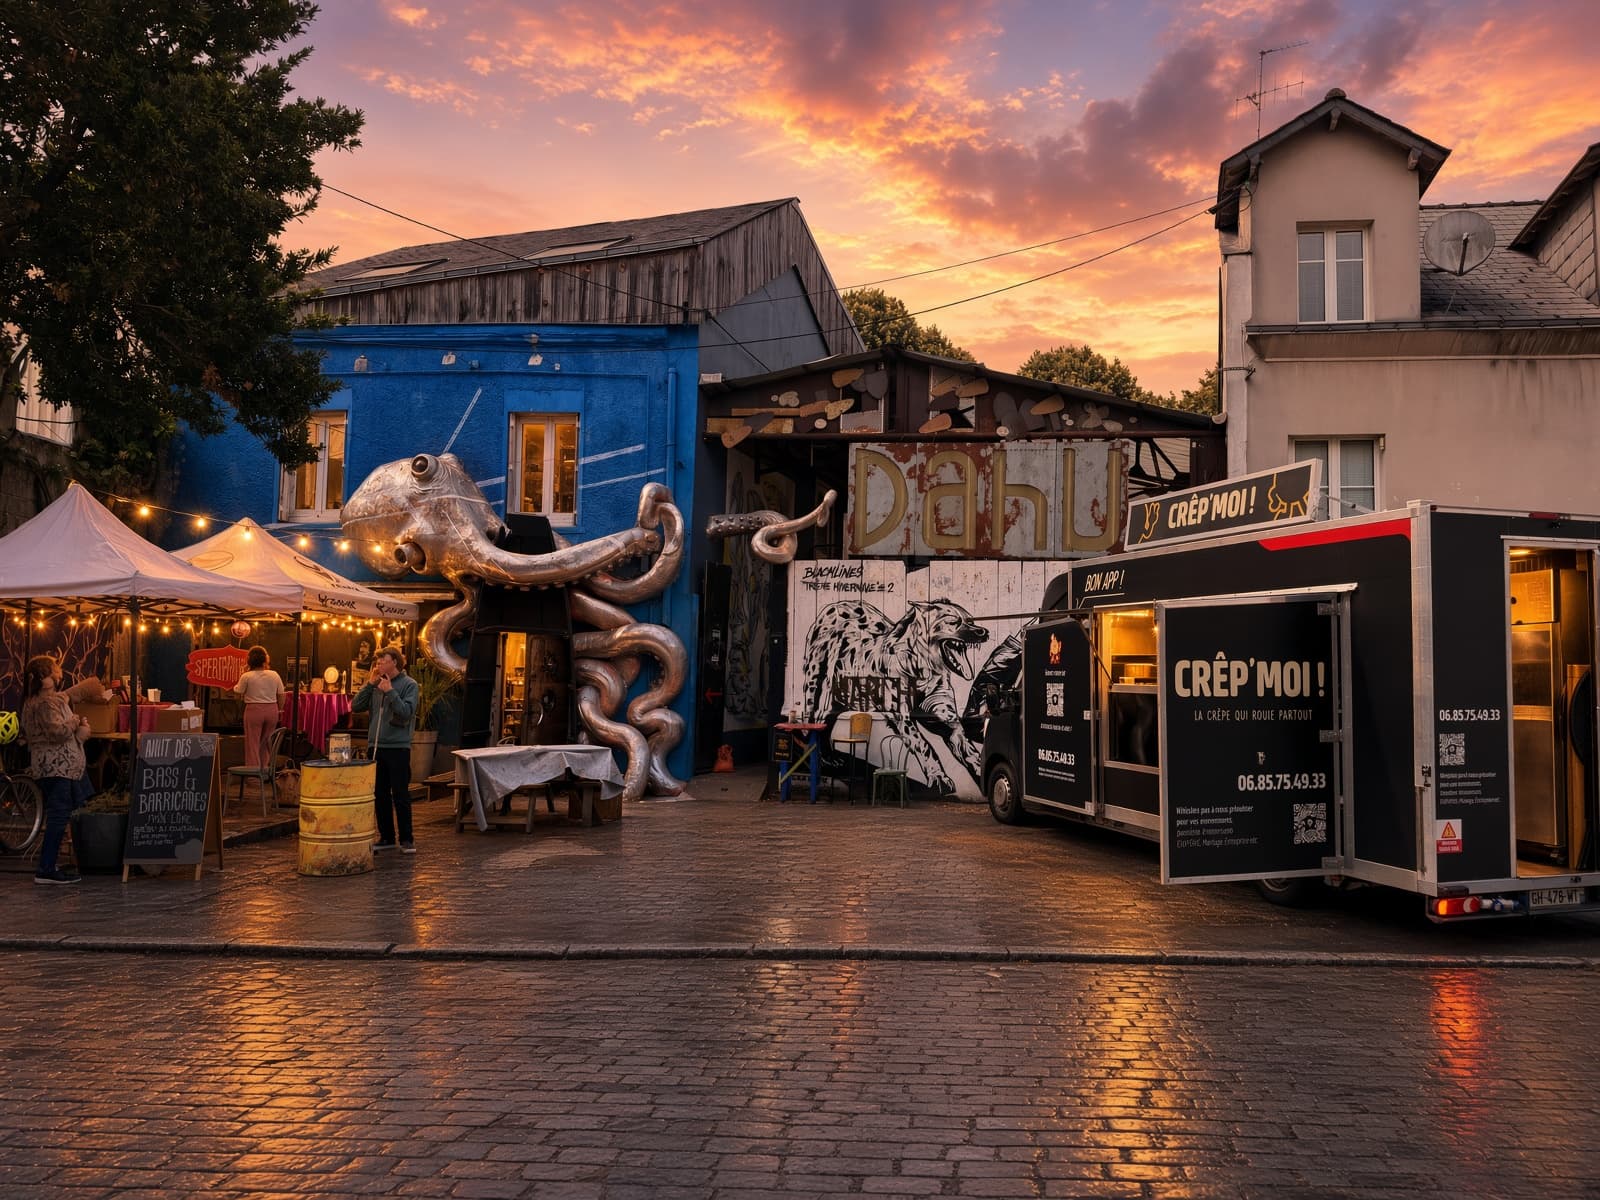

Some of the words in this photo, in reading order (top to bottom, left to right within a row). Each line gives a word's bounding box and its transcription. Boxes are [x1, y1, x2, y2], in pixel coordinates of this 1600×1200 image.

[1085, 572, 1103, 592] BON
[1102, 570, 1119, 590] APP
[1174, 650, 1310, 698] CRÊP'MOI
[1194, 709, 1204, 721] LA
[1234, 709, 1249, 722] QUI
[1279, 709, 1312, 721] PARTOUT
[1439, 709, 1501, 721] 06.85.75.49.33
[142, 766, 180, 790] BASS
[1237, 772, 1327, 792] 06.85.75.49.33
